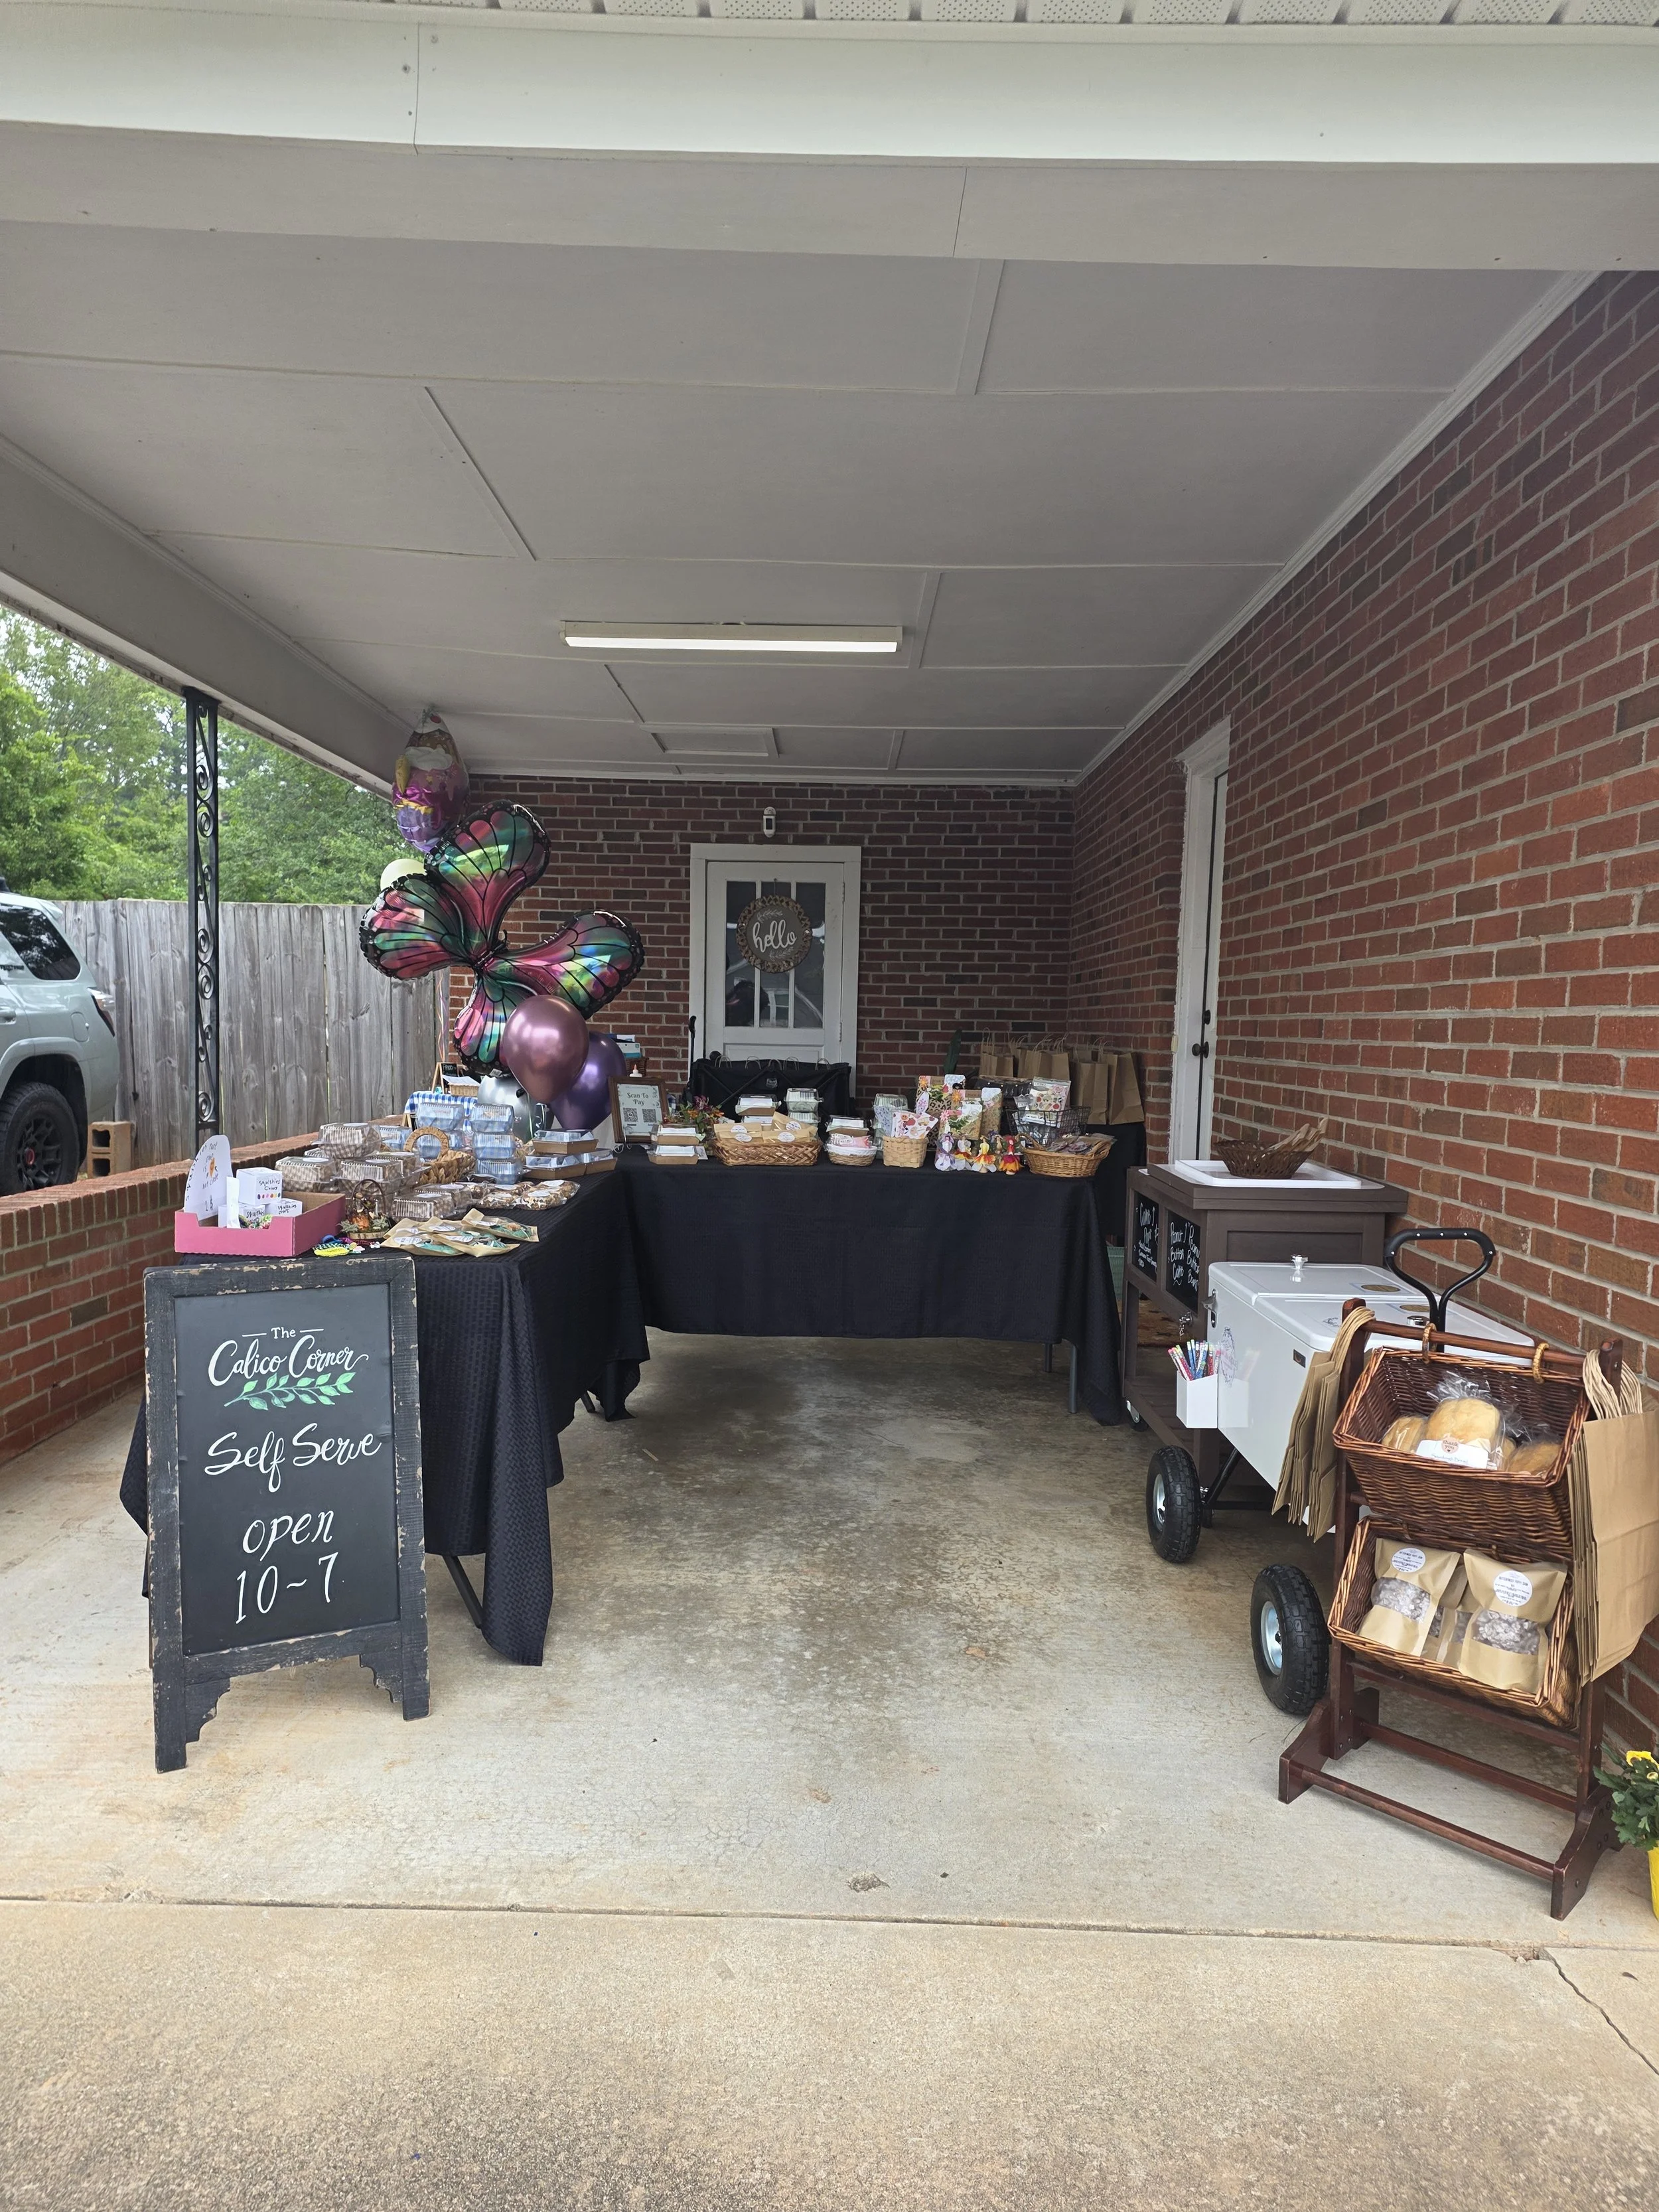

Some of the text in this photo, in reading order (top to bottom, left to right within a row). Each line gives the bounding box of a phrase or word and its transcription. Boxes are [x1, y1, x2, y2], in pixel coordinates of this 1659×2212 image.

[752, 920, 797, 953] hello
[270, 1327, 297, 1339] The
[208, 1335, 370, 1386] Calico Corner
[204, 1422, 382, 1493] Self Serve
